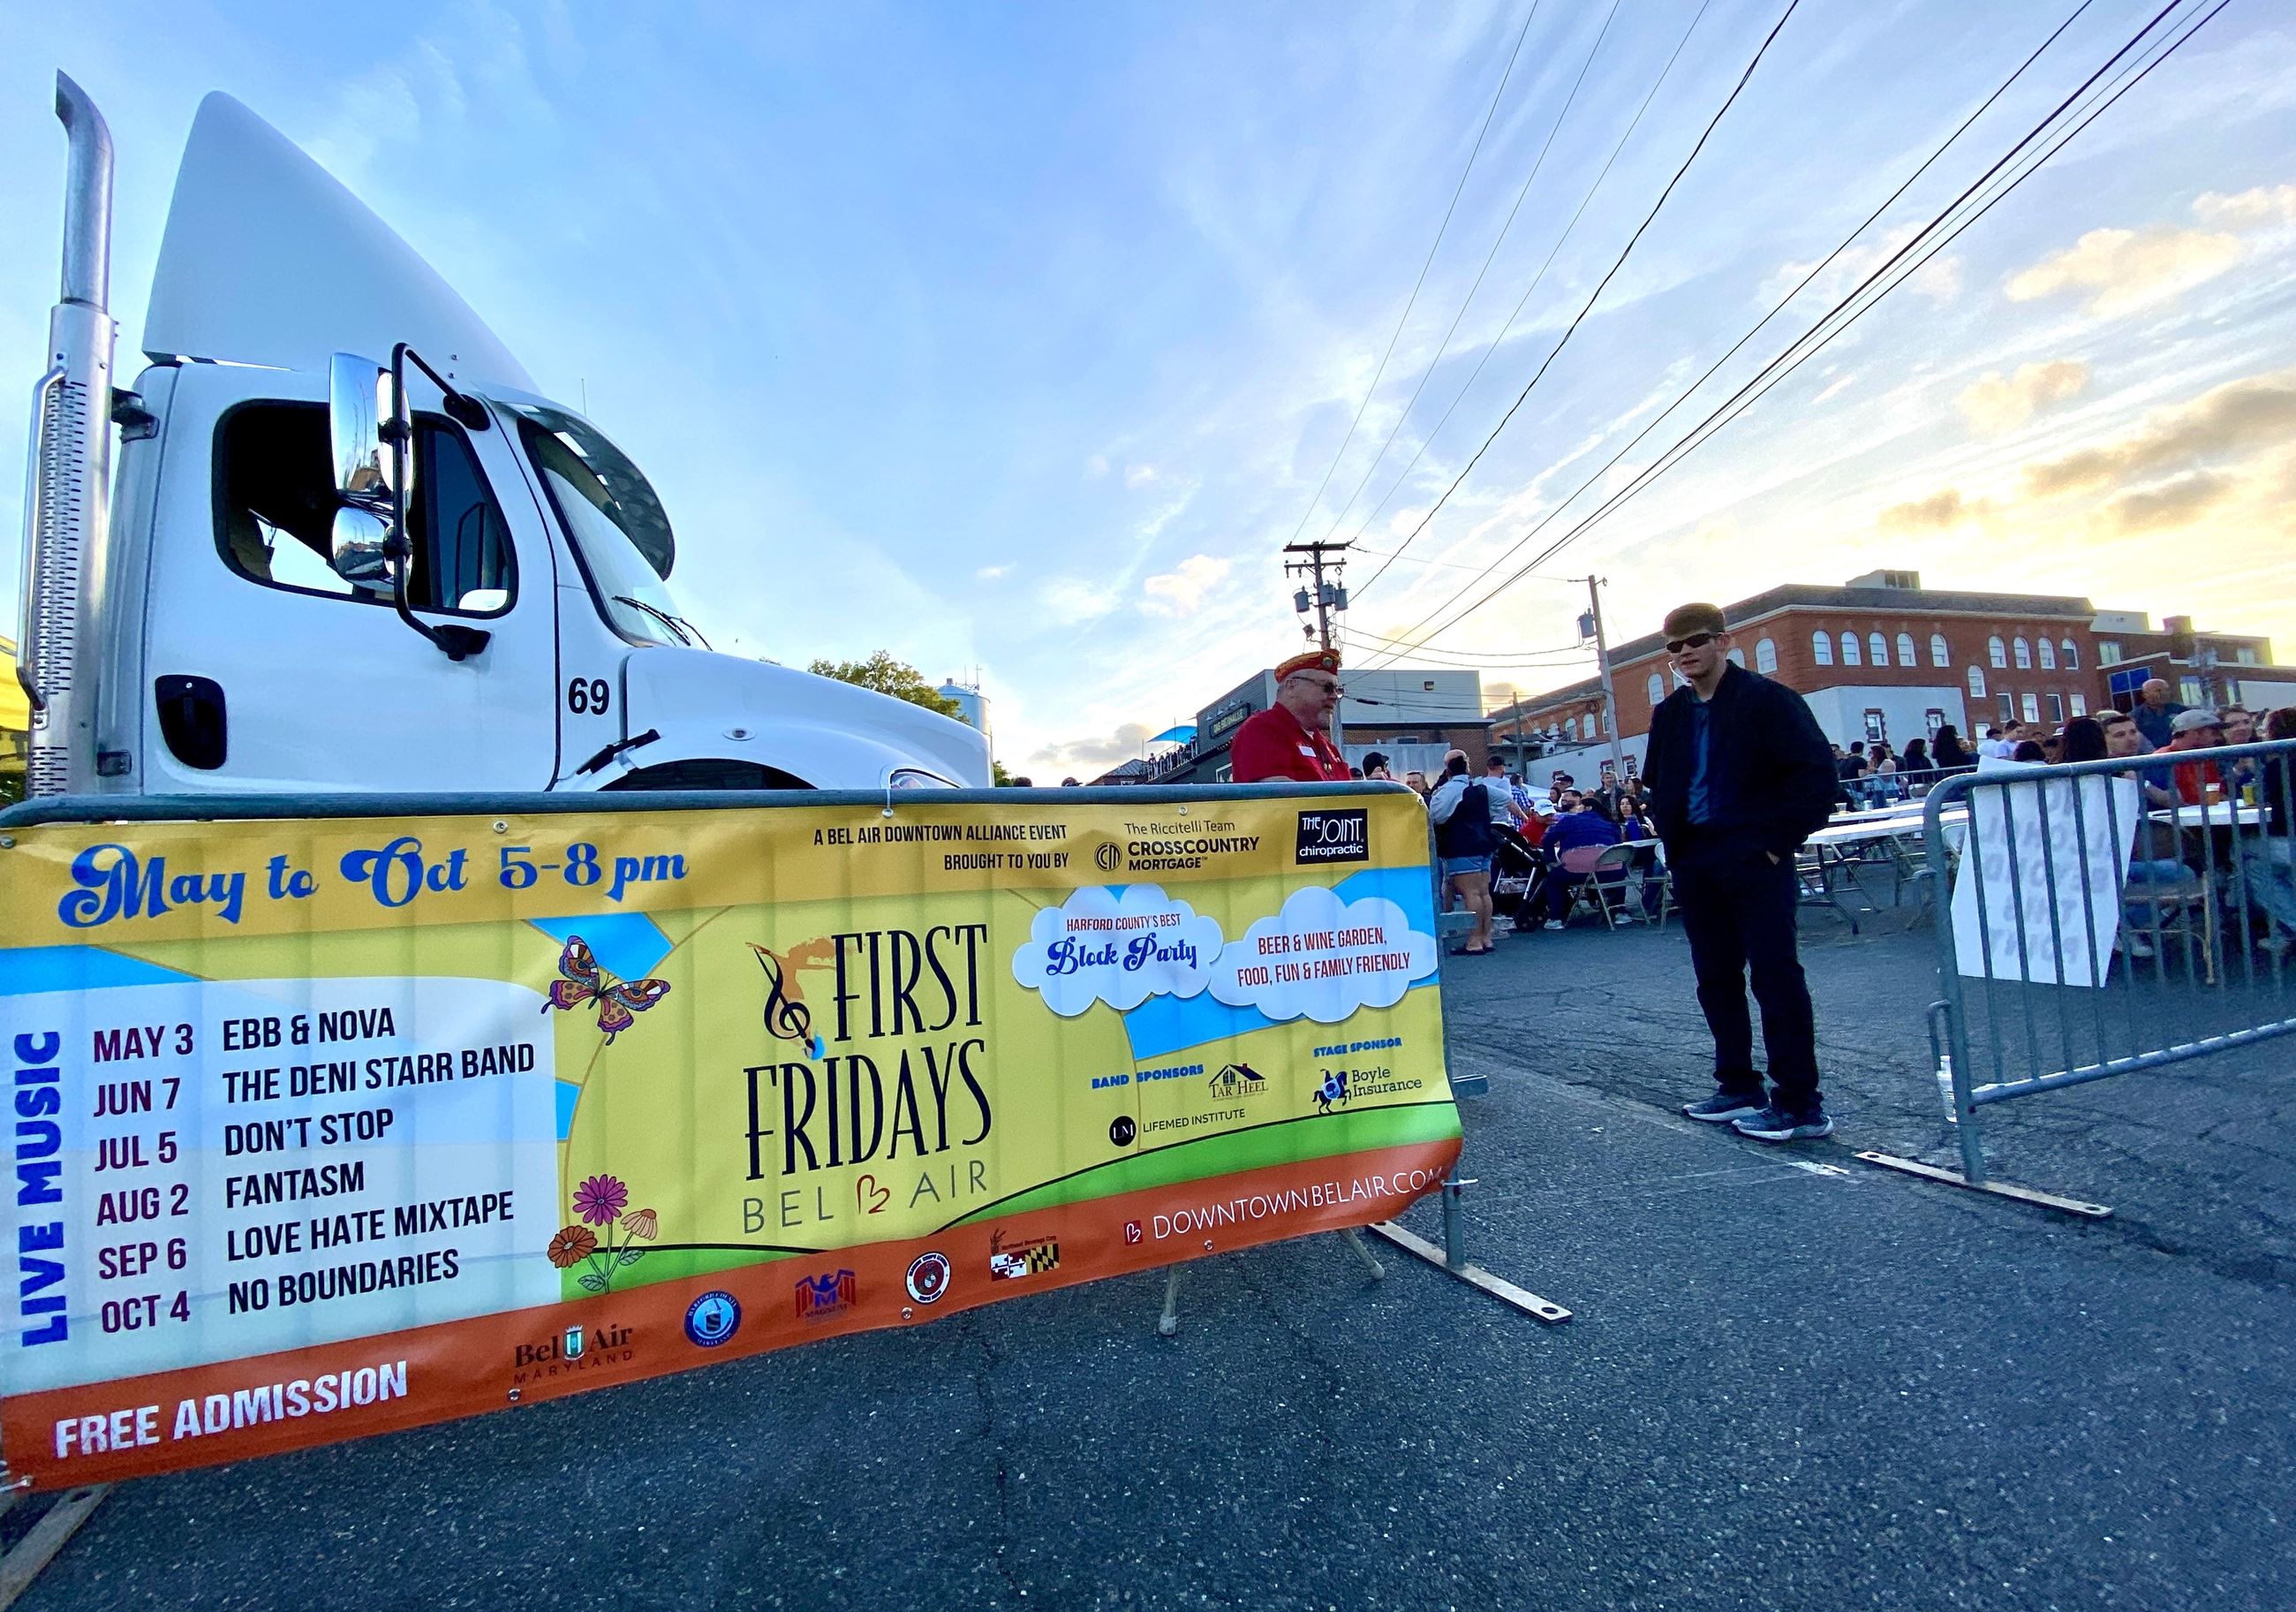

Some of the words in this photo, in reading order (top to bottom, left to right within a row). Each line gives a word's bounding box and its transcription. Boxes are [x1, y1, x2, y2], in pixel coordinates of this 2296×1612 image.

[568, 677, 610, 715] 69
[813, 829, 824, 845] A
[827, 828, 855, 845] BEL
[857, 827, 881, 844] AIR
[885, 824, 963, 842] DOWNTOWN
[966, 824, 1027, 840] ALLIANCE
[1029, 824, 1068, 839] EVENT
[1124, 823, 1148, 835] The
[1150, 821, 1201, 835] Riccitelli
[1204, 820, 1235, 833] Team
[1127, 836, 1260, 856] CROSSCOUNTRY
[1302, 816, 1321, 830] THE
[1317, 818, 1363, 843] JOINT
[943, 852, 1004, 870] BROUGHT
[1007, 853, 1023, 869] TO
[1027, 852, 1051, 868] YOU
[1054, 851, 1069, 868] BY
[1299, 844, 1363, 857] chiropractic
[58, 843, 245, 928] May
[266, 854, 320, 899] to
[339, 836, 469, 907] Oct
[1067, 914, 1114, 932] HARFORD
[1115, 913, 1159, 930] COUNTY'S
[1159, 912, 1182, 927] BEST
[1258, 935, 1291, 956] BEER
[1293, 934, 1303, 951] &
[1303, 932, 1336, 951] WINE
[1338, 926, 1387, 950] GARDEN,
[1046, 935, 1120, 976] Block
[1122, 932, 1197, 971] Party
[1236, 966, 1273, 988] FOOD,
[1275, 962, 1301, 983] FUN
[1303, 962, 1312, 980] &
[1314, 957, 1354, 980] FAMILY
[1356, 952, 1411, 976] FRIENDLY
[831, 924, 988, 1042] FIRST
[93, 1028, 165, 1063] MAY
[174, 1023, 194, 1056] 3
[223, 1017, 282, 1052] EBB
[291, 1014, 311, 1046] &
[318, 1007, 397, 1043] NOVA
[1312, 1043, 1348, 1058] STAGE
[1349, 1036, 1403, 1054] SPONSOR
[223, 1069, 282, 1104] THE
[290, 1060, 357, 1097] DENI
[365, 1051, 453, 1091] STARR
[462, 1042, 535, 1078] BAND
[1091, 1073, 1129, 1090] BAND
[1136, 1063, 1205, 1083] SPONSORS
[1351, 1065, 1392, 1084] Boyle
[1352, 1077, 1424, 1098] Insurance
[93, 1080, 153, 1117] JUN
[162, 1078, 181, 1110] 7
[743, 1038, 993, 1181] FRIDAYS
[13, 1030, 63, 1207] MUSIC
[224, 1117, 312, 1156] DON'T
[320, 1108, 394, 1147] STOP
[1142, 1117, 1190, 1132] LIFEMED
[1191, 1108, 1246, 1126] INSTITUTE
[94, 1134, 148, 1172] JUL
[158, 1131, 177, 1164] 5
[96, 1188, 160, 1226] AUG
[170, 1183, 189, 1216] 2
[226, 1161, 366, 1208] FANTASM
[743, 1186, 835, 1235] BEL
[909, 1160, 988, 1208] AIR
[228, 1222, 302, 1261] LOVE
[310, 1210, 386, 1251] HATE
[394, 1190, 515, 1237] MIXTAPE
[98, 1241, 158, 1279] SEP
[167, 1237, 187, 1270] 6
[21, 1221, 68, 1348] LIVE
[229, 1279, 269, 1314] NO
[278, 1248, 459, 1307] BOUNDARIES
[102, 1295, 161, 1334] OCT
[170, 1290, 191, 1323] 4
[515, 1335, 559, 1368] Bel
[588, 1322, 634, 1353] Air
[513, 1349, 633, 1385] MARYLAND
[55, 1404, 161, 1458] FREE
[173, 1360, 408, 1440] ADMISSION
